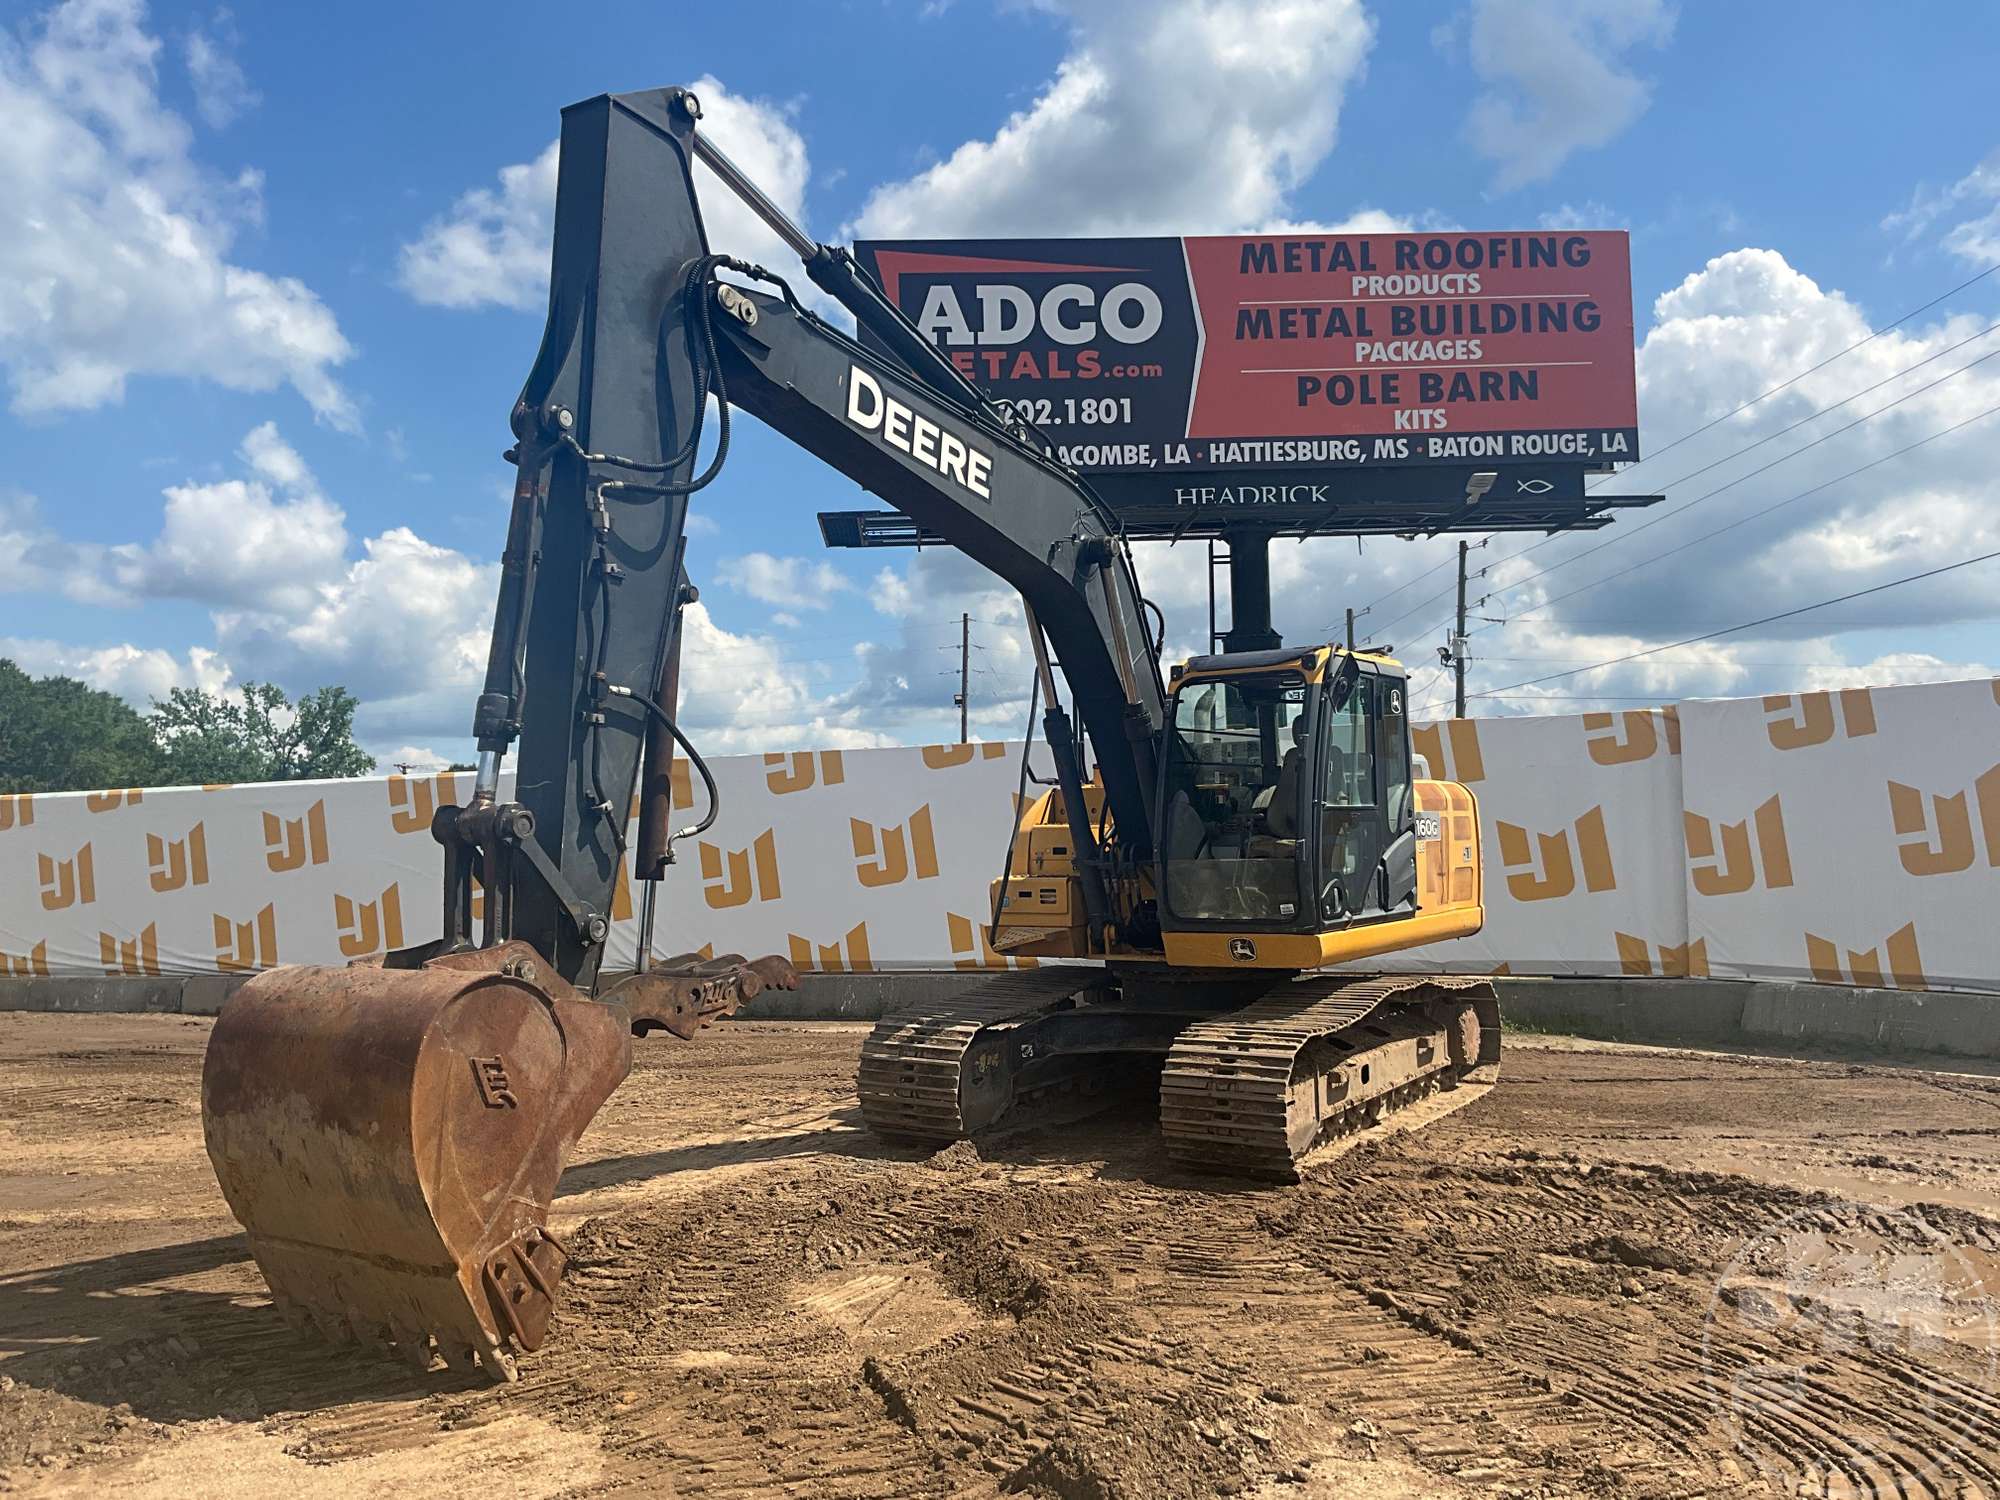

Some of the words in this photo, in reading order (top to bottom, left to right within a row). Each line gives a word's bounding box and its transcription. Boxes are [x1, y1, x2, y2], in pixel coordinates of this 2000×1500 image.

[1239, 240, 1377, 274] METAL
[1394, 236, 1591, 270] ROOFING
[1352, 273, 1481, 296] PRODUCTS
[917, 282, 1163, 346] ADCO
[1235, 306, 1373, 340] METAL
[1391, 301, 1601, 335] BUILDING
[951, 350, 1163, 380] ETALS.com
[1355, 339, 1483, 363] PACKAGES
[1297, 373, 1400, 406] POLE
[1418, 370, 1539, 403] BARN
[847, 364, 992, 500] DEERE
[1394, 408, 1448, 431] KITS
[1164, 443, 1191, 464] LA
[1209, 439, 1368, 465] HATTIESBURG,
[1373, 438, 1410, 460] MS
[1428, 435, 1504, 458] BATON
[1511, 432, 1596, 457] ROUGE,
[1601, 431, 1628, 453] LA
[1174, 485, 1331, 505] HEADRICK
[1415, 818, 1438, 838] 160G
